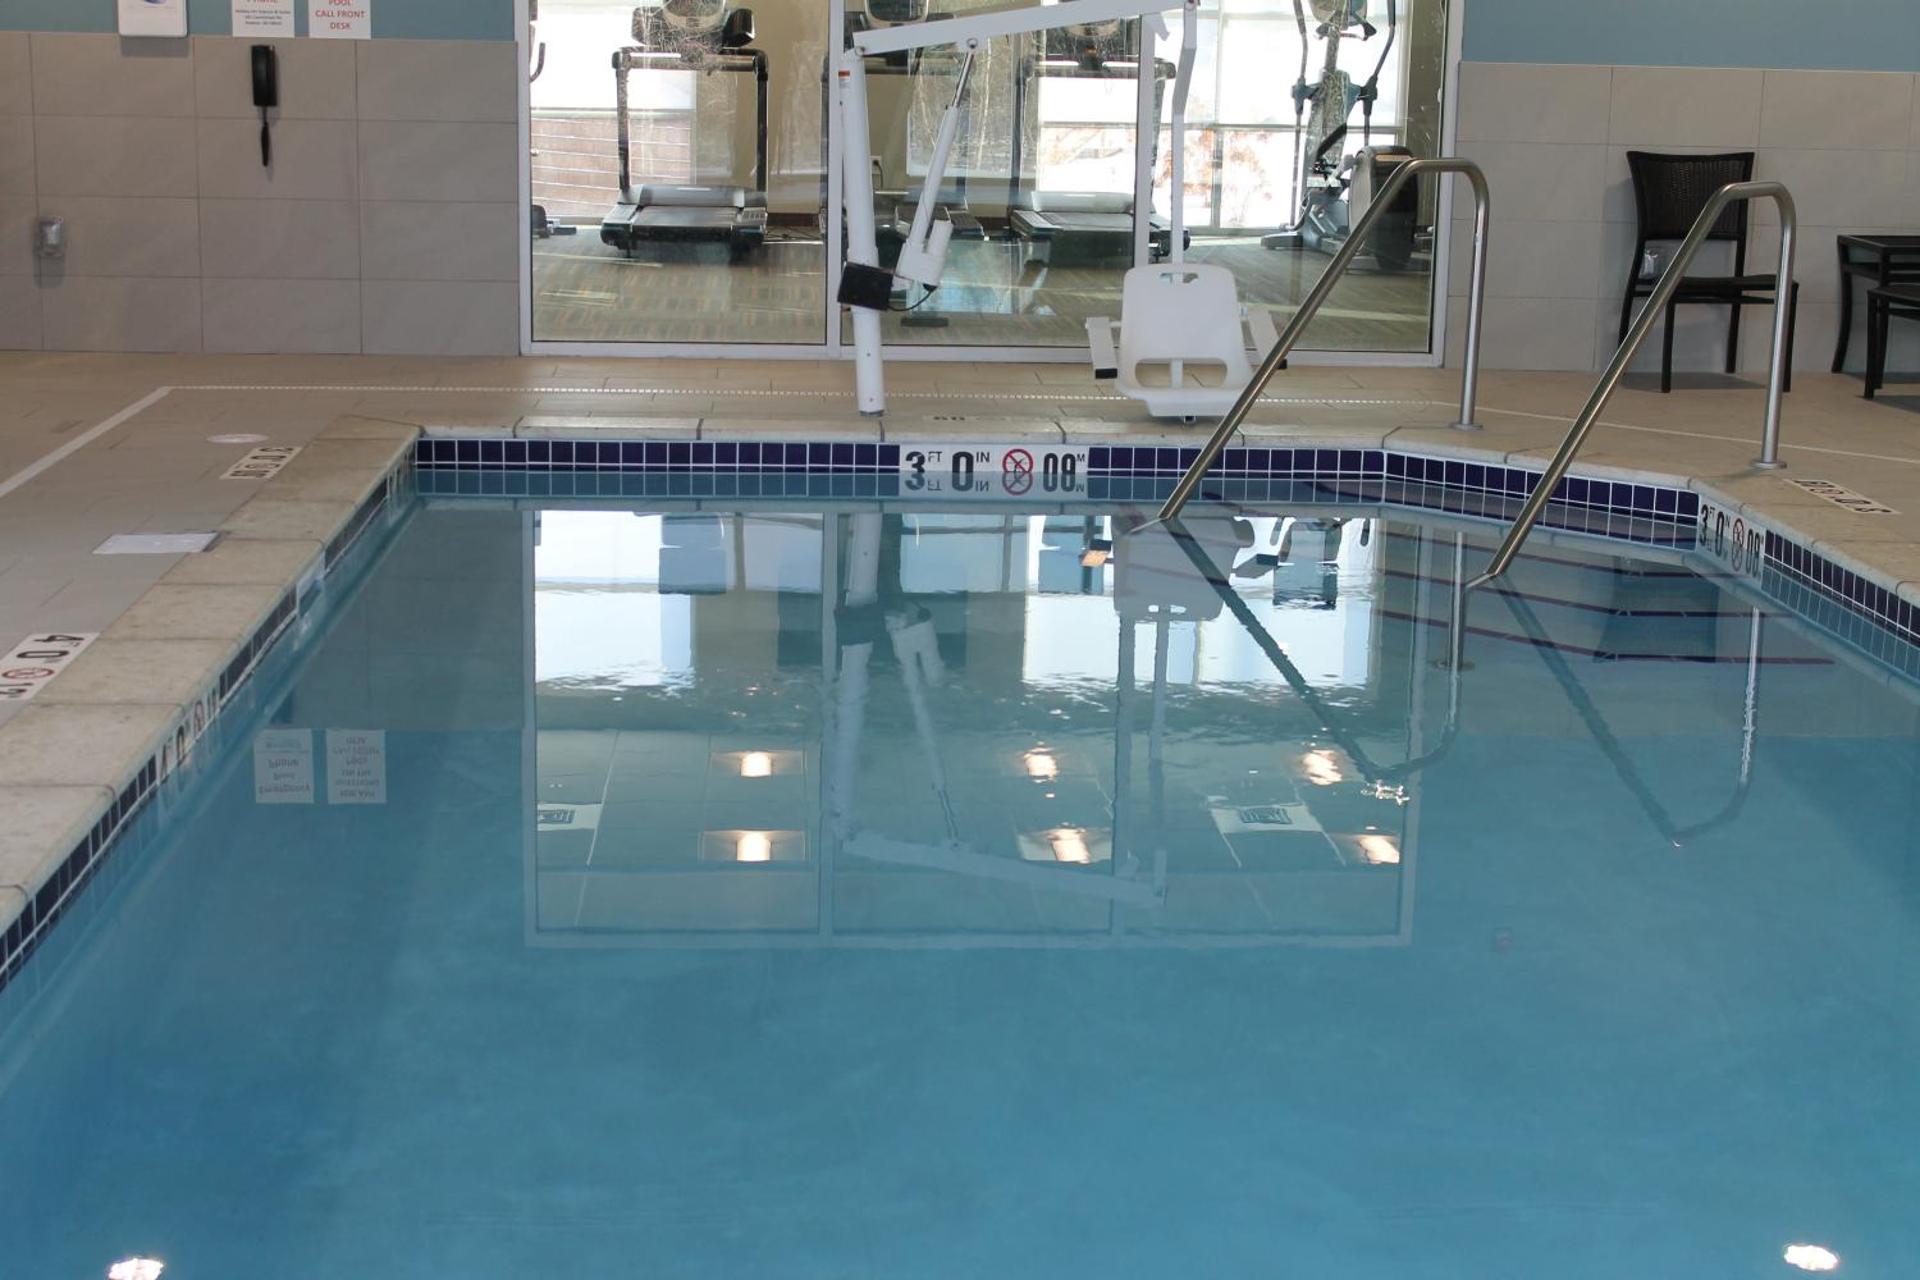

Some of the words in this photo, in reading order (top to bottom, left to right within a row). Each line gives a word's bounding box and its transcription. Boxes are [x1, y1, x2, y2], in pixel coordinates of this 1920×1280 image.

[315, 10, 334, 18] CALL
[337, 10, 366, 18] FRONT
[905, 451, 925, 490] 3
[927, 451, 943, 463] FT
[951, 451, 974, 491] 0
[976, 452, 990, 463] IN
